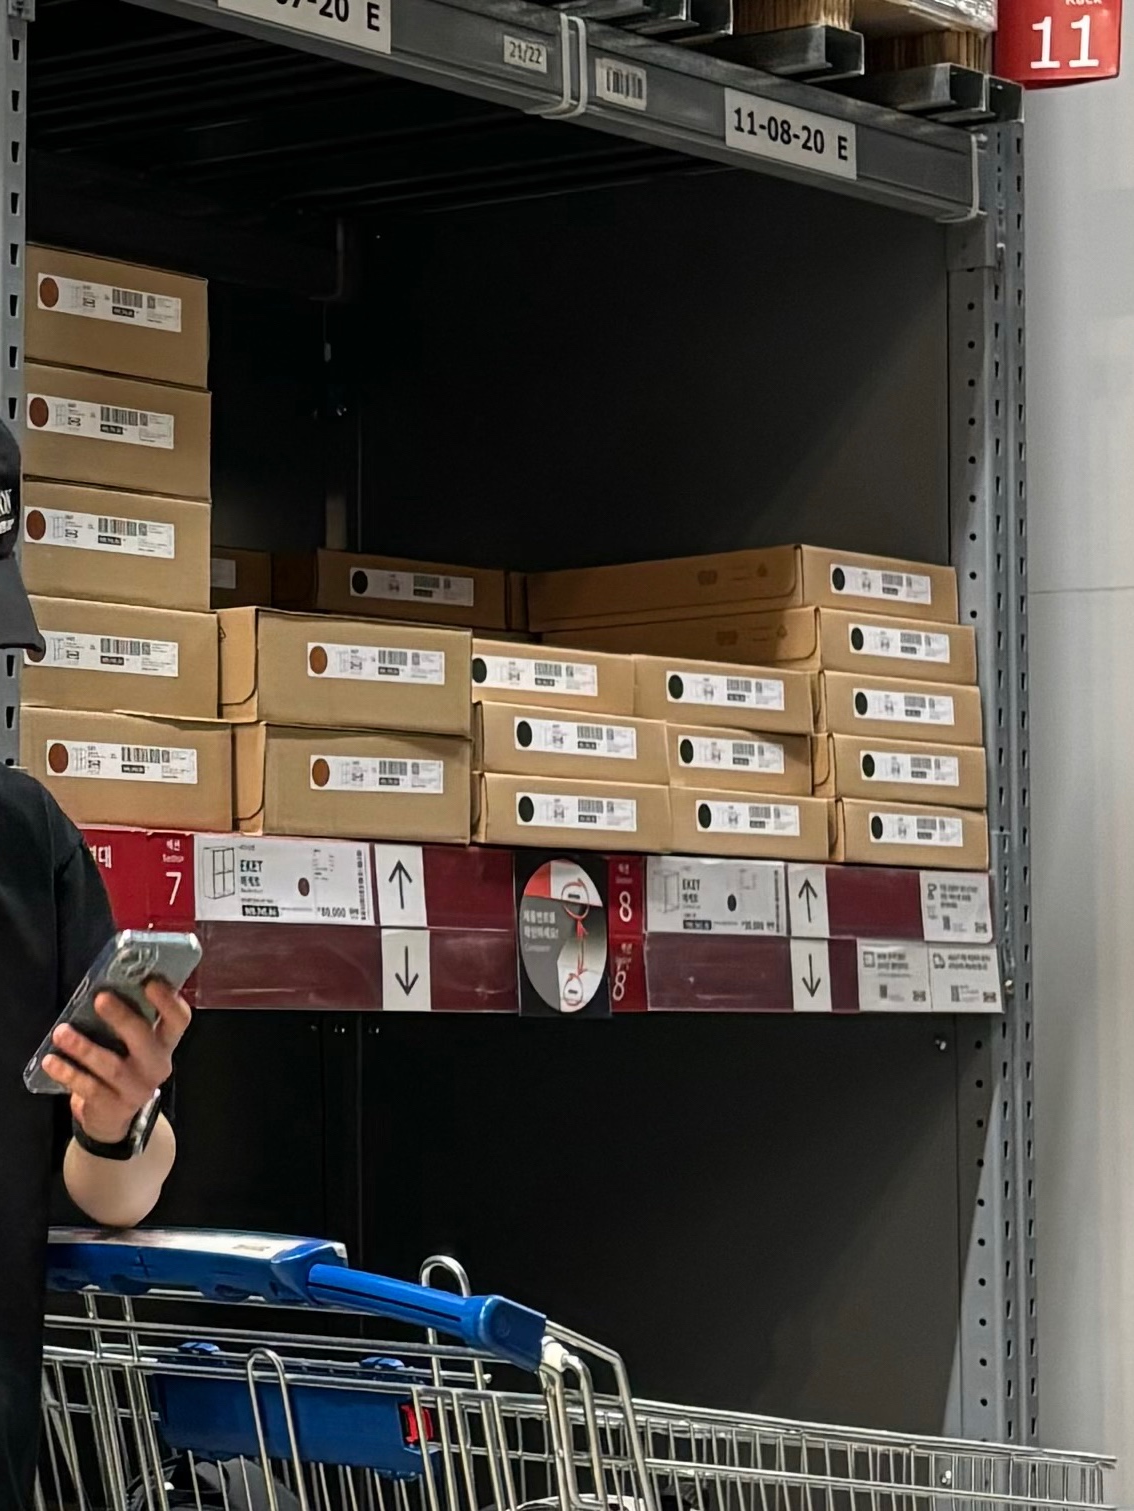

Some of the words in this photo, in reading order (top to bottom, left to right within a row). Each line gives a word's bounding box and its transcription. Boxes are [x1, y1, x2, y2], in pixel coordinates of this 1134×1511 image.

[367, 2, 380, 32] E
[509, 41, 542, 65] 21/22
[1030, 15, 1100, 69] 11
[733, 107, 825, 154] 11-08-20
[837, 136, 849, 161] E
[166, 871, 182, 905] 7
[619, 891, 633, 922] 8
[612, 970, 627, 1001] 8
